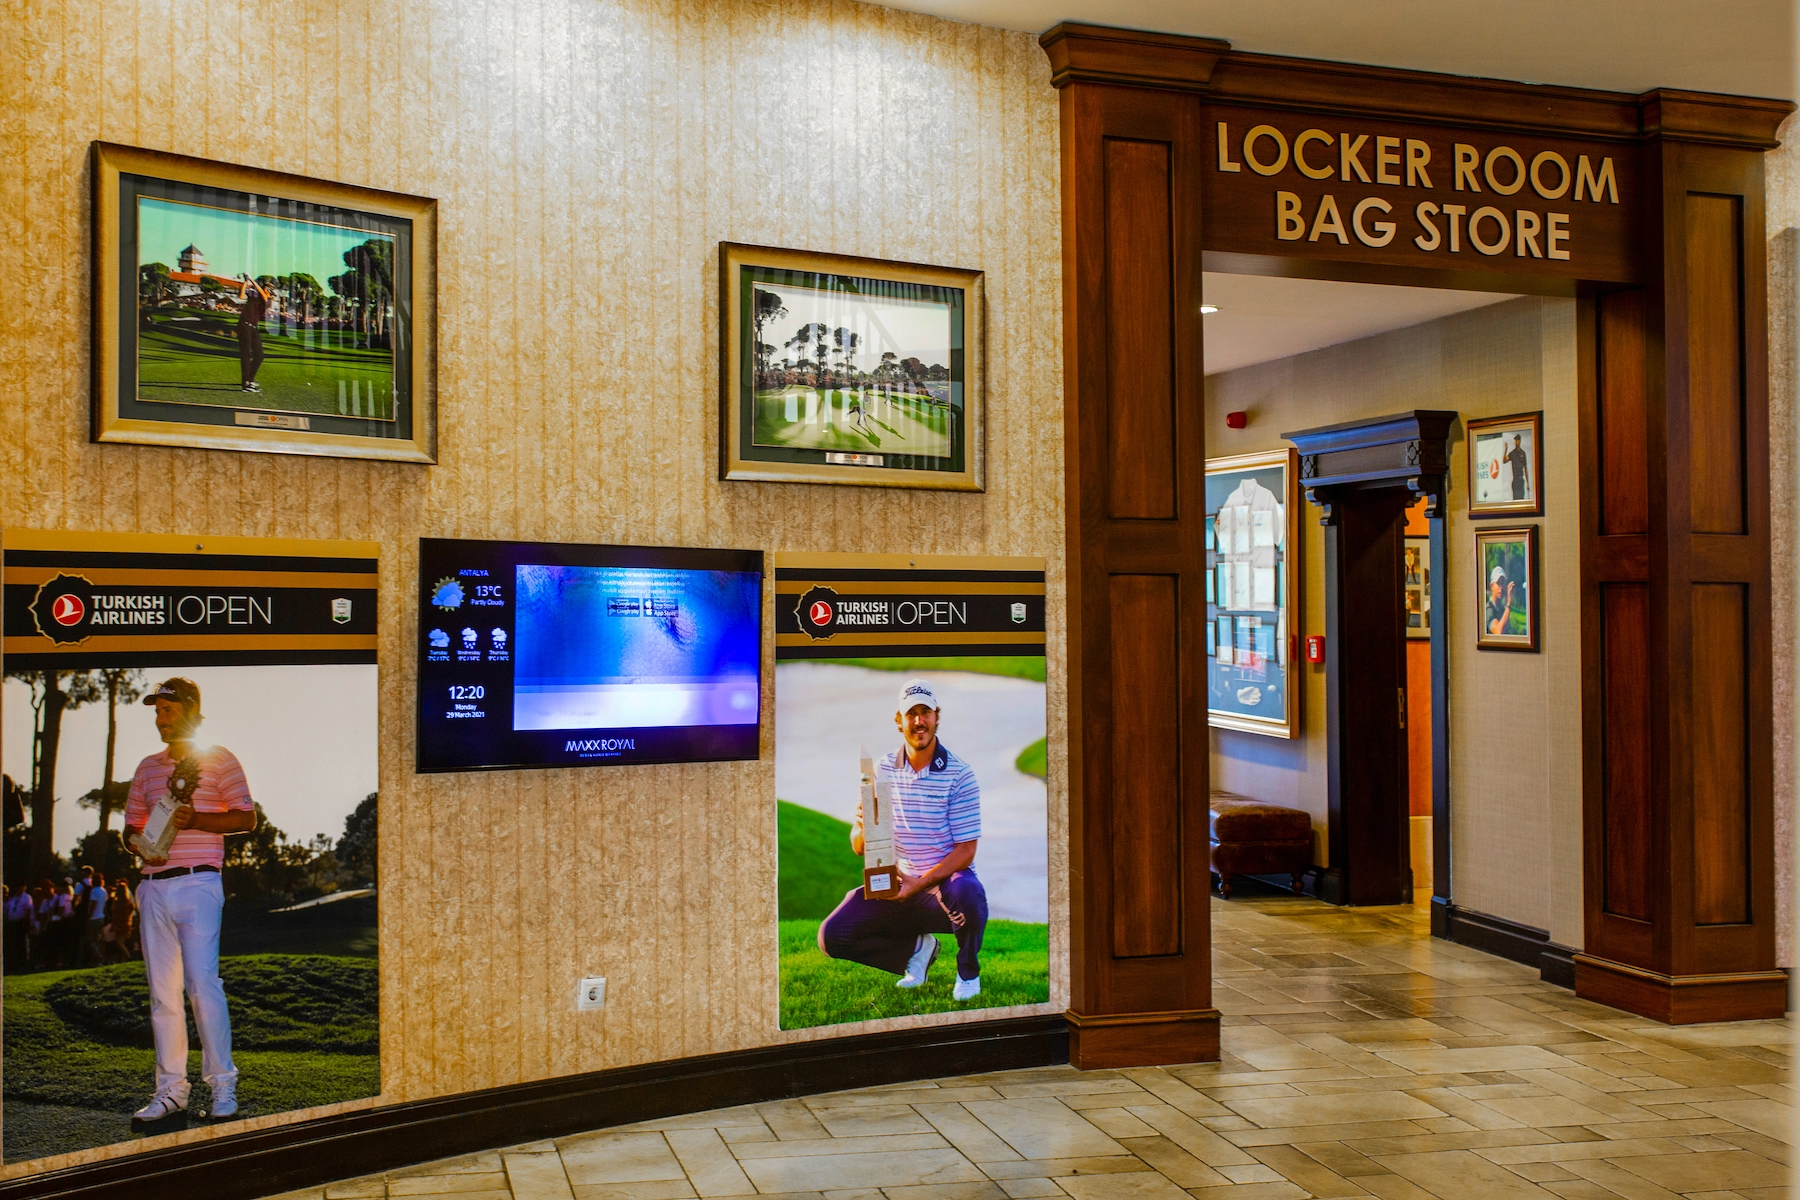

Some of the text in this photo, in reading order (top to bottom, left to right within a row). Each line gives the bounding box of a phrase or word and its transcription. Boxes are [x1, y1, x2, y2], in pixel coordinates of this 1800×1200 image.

[1217, 121, 1620, 204] LOCKER ROOM
[1275, 190, 1571, 261] BAG STORE
[459, 569, 489, 577] ANTALYA
[475, 585, 502, 597] 13°C
[90, 595, 165, 610] TURKISH
[470, 599, 505, 607] Partly Cloudy
[836, 602, 889, 613] TURKISH
[177, 595, 272, 625] OPEN
[897, 601, 967, 625] OPEN
[90, 611, 166, 625] AIRLINES
[836, 614, 889, 625] AIRLINES
[448, 685, 485, 700] 12:20
